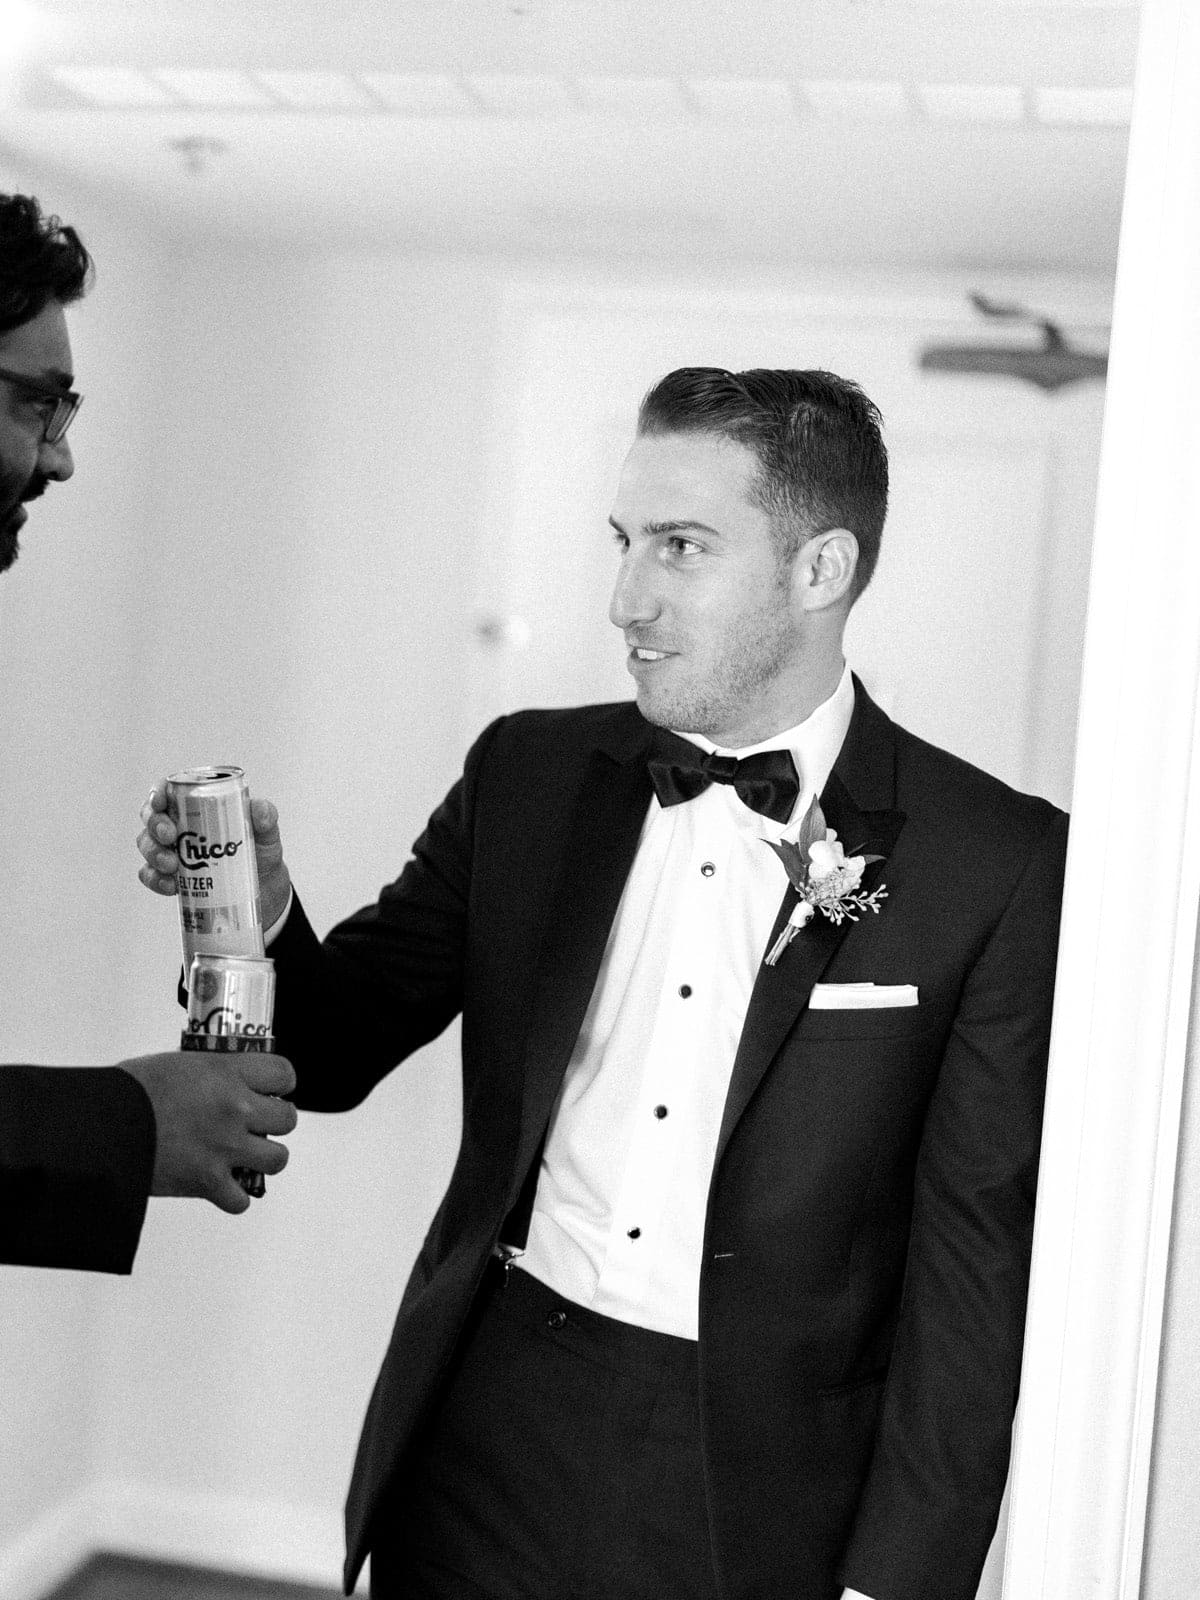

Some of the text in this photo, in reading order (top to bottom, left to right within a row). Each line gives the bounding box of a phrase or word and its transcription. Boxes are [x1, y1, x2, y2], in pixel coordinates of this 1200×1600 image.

[177, 831, 243, 870] Chico
[179, 876, 214, 890] ELTZER
[204, 1007, 271, 1036] Chico
